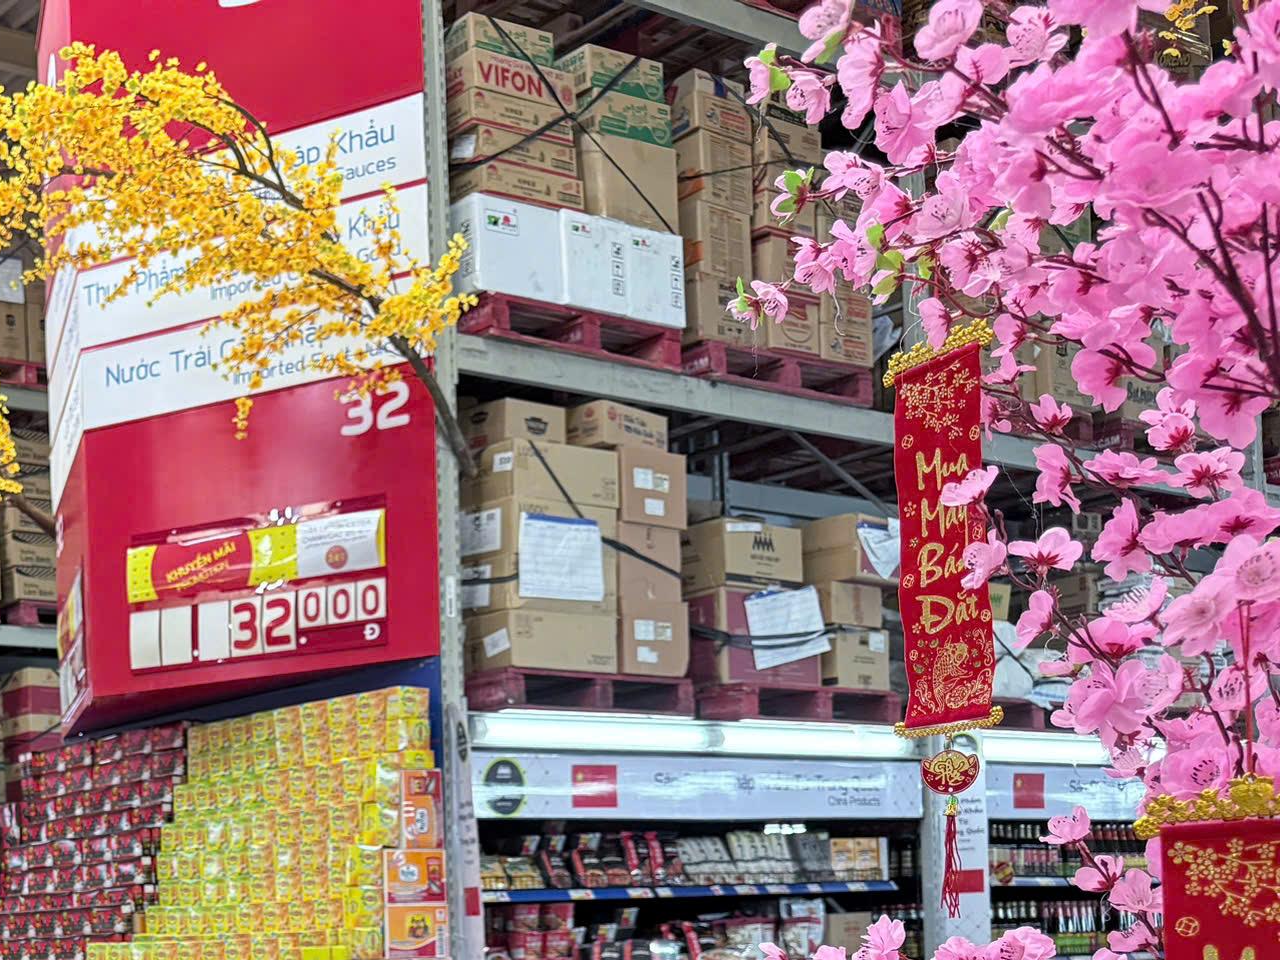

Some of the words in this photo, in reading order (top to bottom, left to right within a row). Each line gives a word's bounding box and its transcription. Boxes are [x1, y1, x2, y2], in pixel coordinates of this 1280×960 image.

[478, 60, 544, 98] VIFON
[105, 358, 161, 388] Nước
[339, 380, 412, 437] 32
[918, 543, 969, 588] Bá
[915, 591, 980, 635] Đắt
